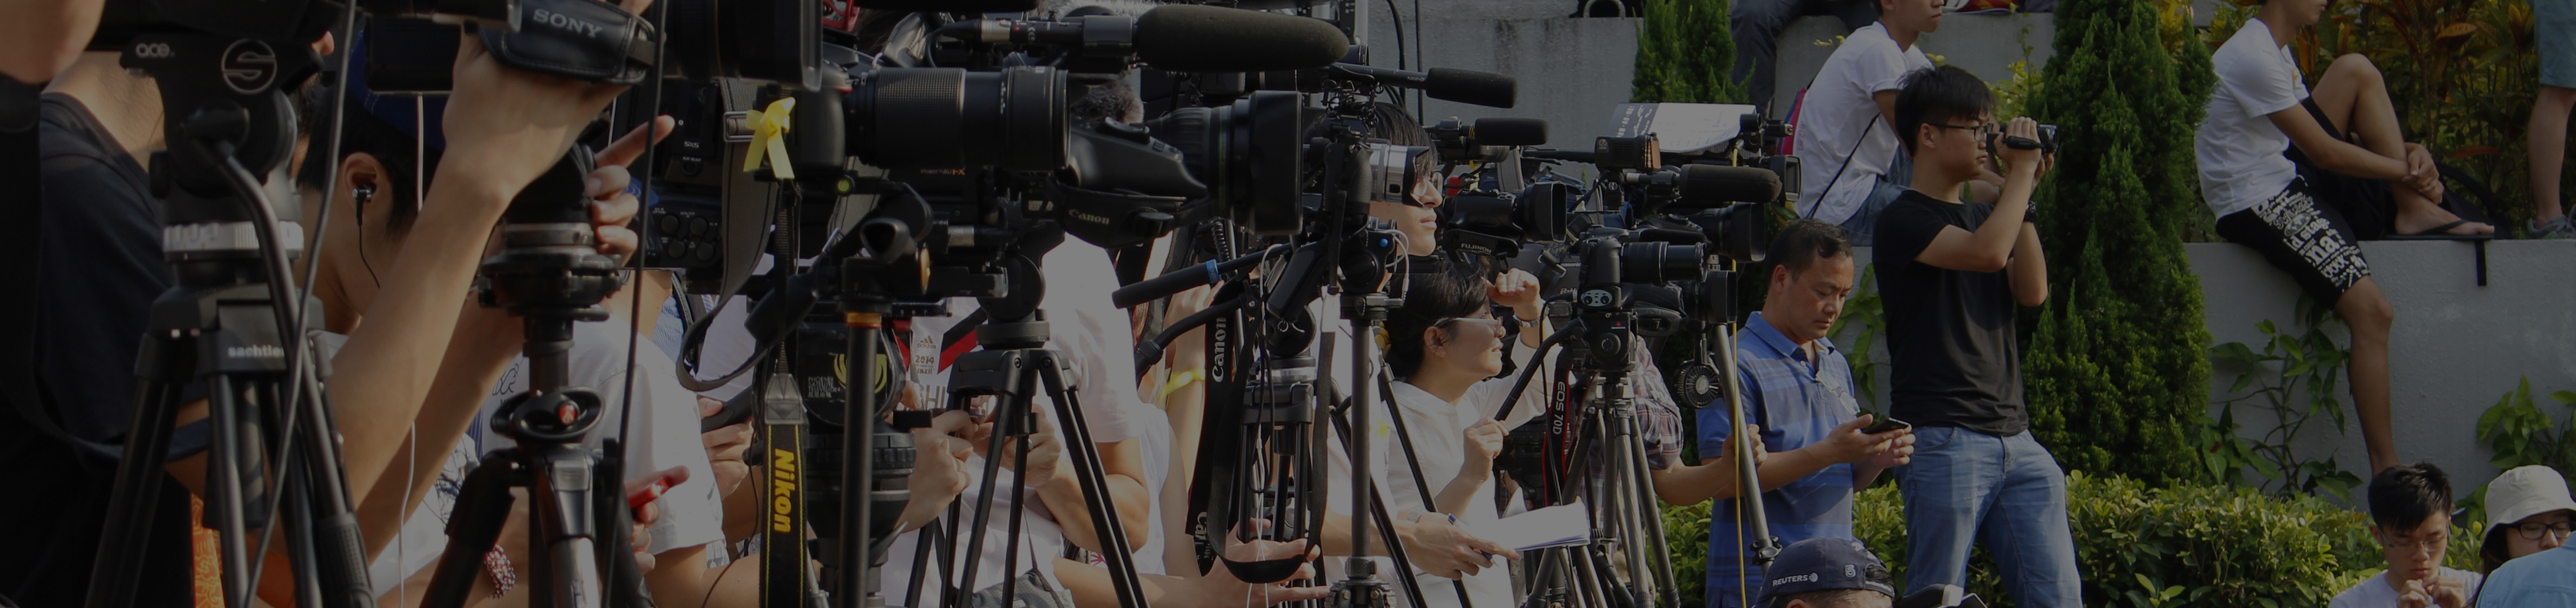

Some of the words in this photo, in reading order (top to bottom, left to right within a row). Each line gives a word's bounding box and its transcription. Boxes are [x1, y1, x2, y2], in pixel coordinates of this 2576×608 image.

[533, 8, 603, 38] SONY
[136, 42, 170, 58] ace
[1068, 209, 1110, 225] Canon
[1461, 242, 1492, 254] FUJINON
[1212, 317, 1226, 383] Canon
[915, 355, 934, 364] 2014
[1556, 381, 1566, 412] EOS
[1553, 413, 1564, 435] 70D
[773, 448, 796, 533] Nikon
[1845, 564, 1856, 578] 5
[1772, 574, 1809, 587] REUTERS
